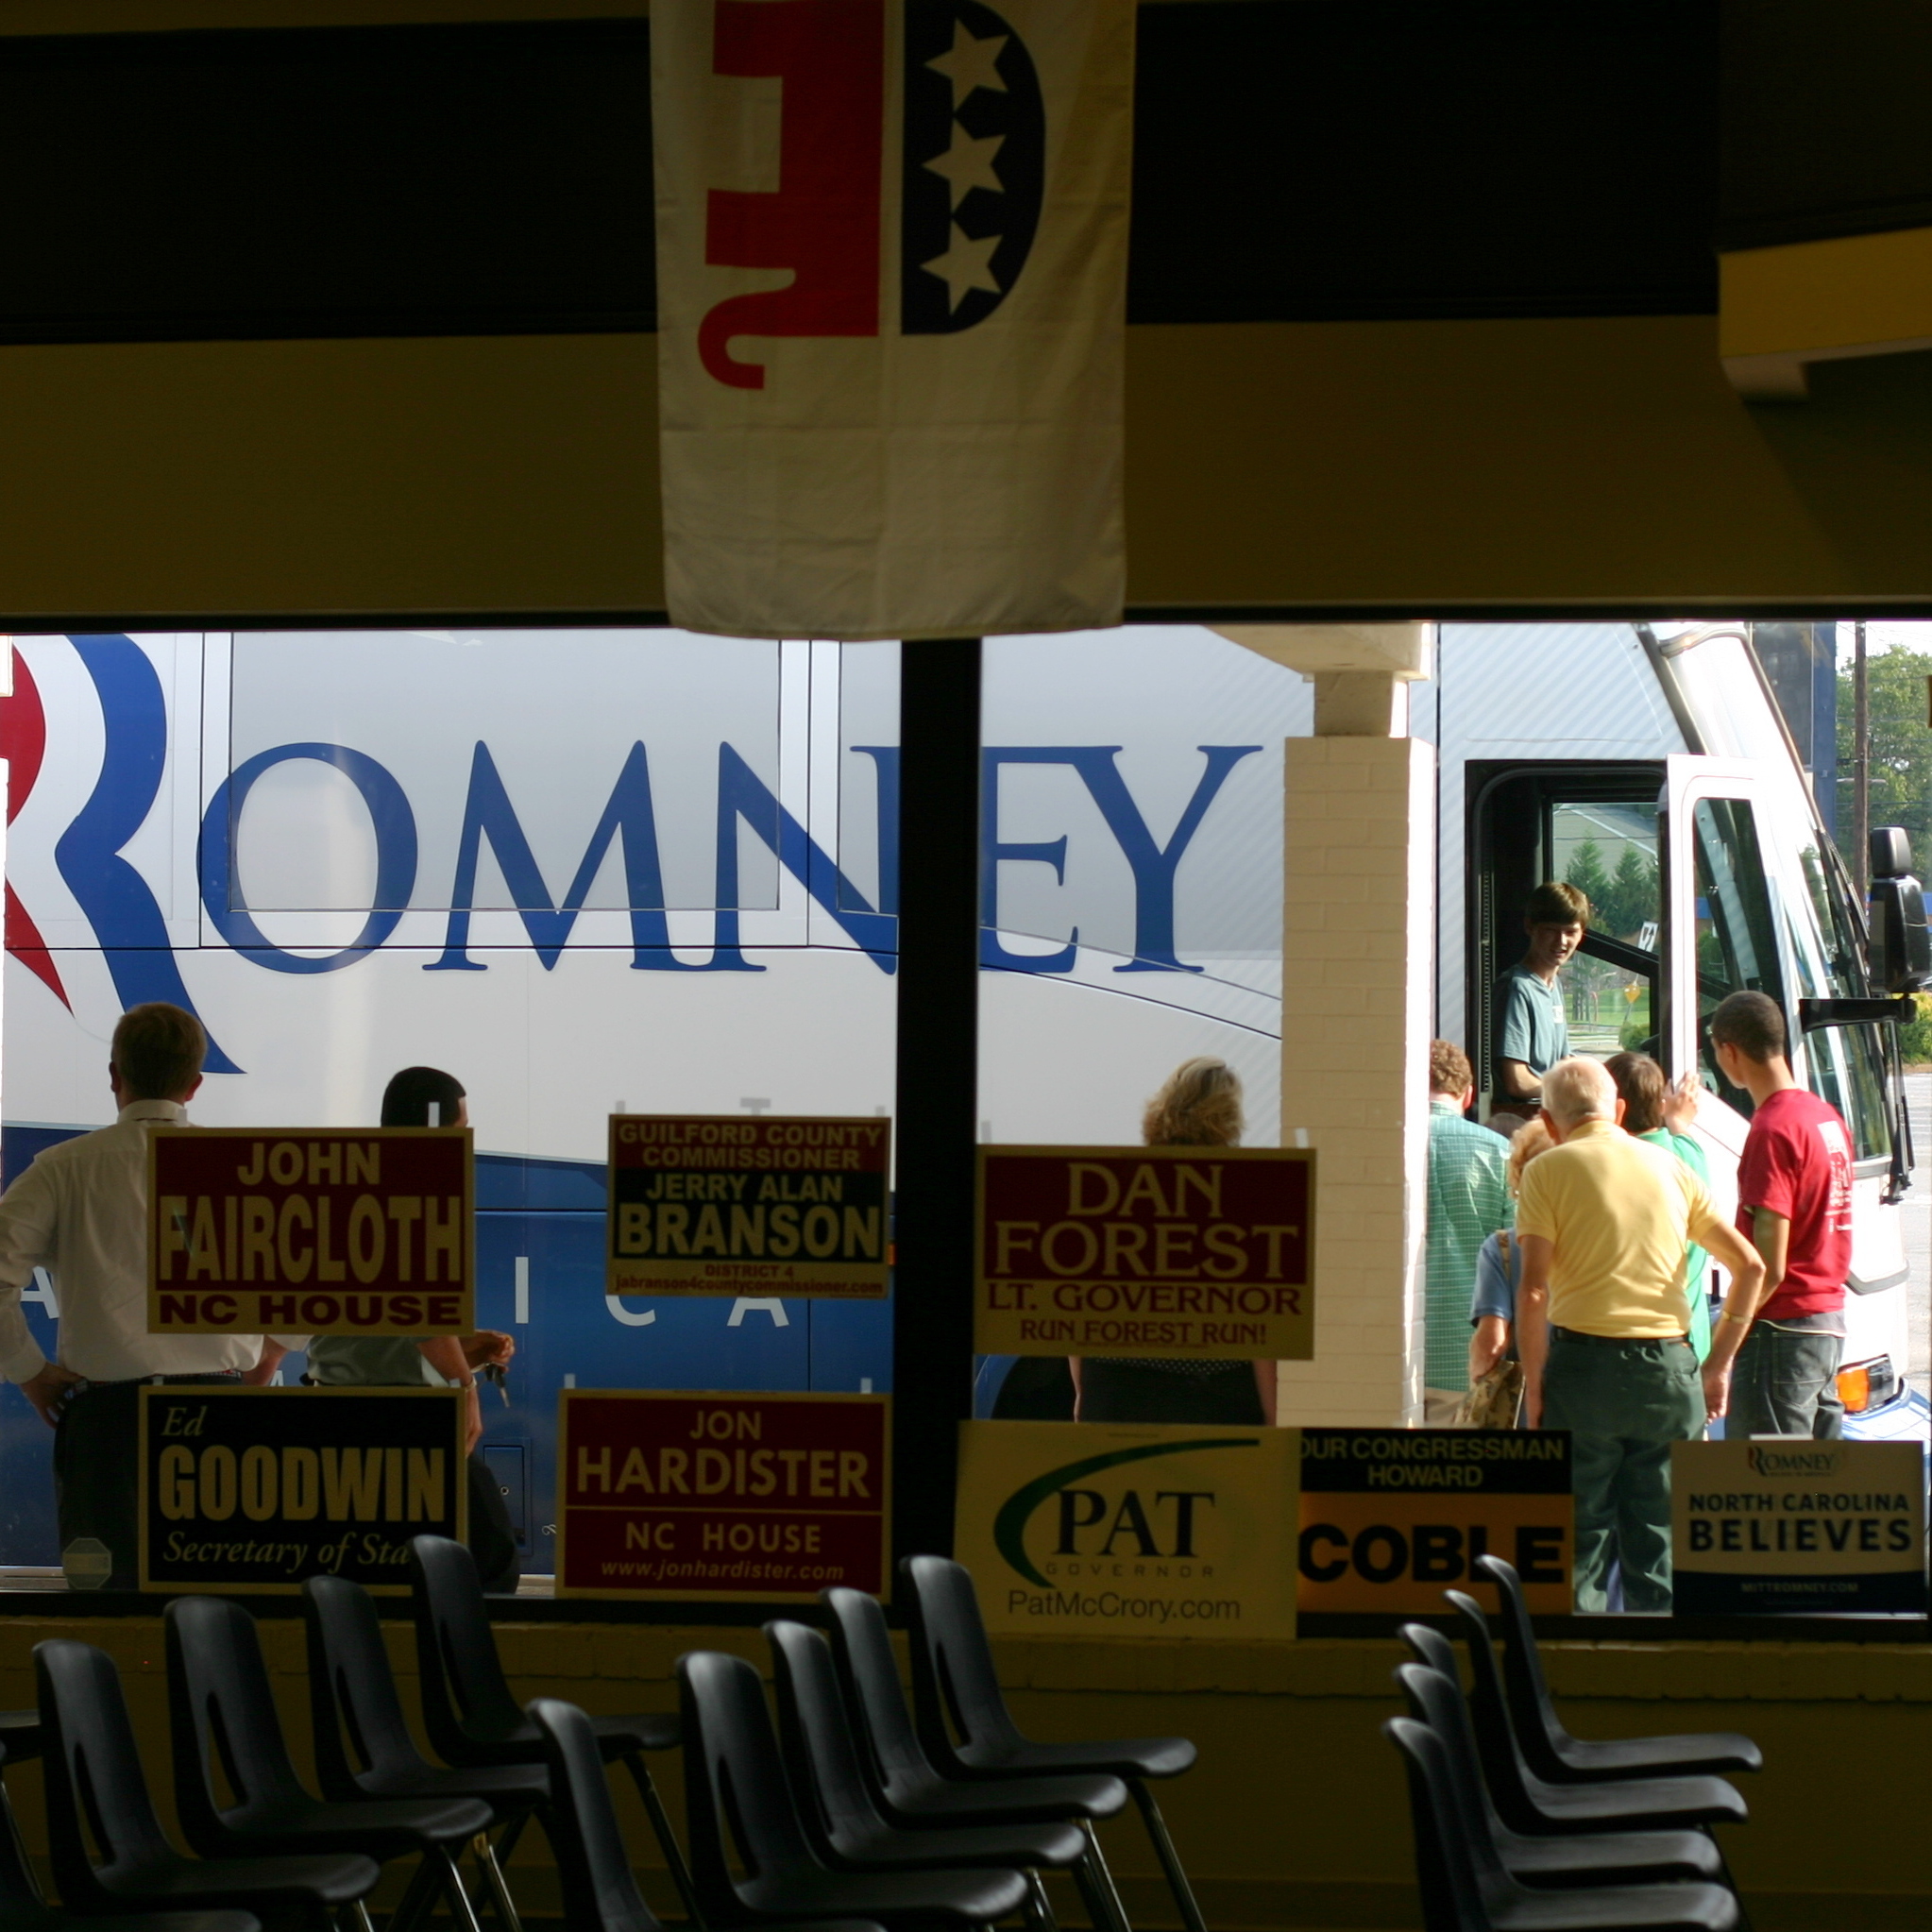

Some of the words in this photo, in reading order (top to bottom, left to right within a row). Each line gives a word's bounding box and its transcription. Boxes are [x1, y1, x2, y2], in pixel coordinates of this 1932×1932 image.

[4, 633, 1263, 1074] ROMNEY
[619, 1123, 756, 1144] GUILFORD
[766, 1125, 883, 1146] COUNTY
[237, 1142, 381, 1185] JOHN
[642, 1145, 860, 1169] COMMISSIONER
[646, 1173, 748, 1200] JERRY
[758, 1175, 843, 1201] ALAN
[1066, 1162, 1224, 1218] DAN
[159, 1194, 461, 1283] FAIRCLOTH
[619, 1202, 880, 1258] BRANSON
[993, 1220, 1298, 1279] FOREST
[615, 1276, 884, 1294] jabranson4countycommissioner.com
[704, 1263, 779, 1278] DISTRICT
[784, 1265, 794, 1278] 4
[159, 1295, 238, 1325] NC
[259, 1296, 461, 1326] HOUSE
[987, 1282, 1037, 1311] LT.
[1052, 1282, 1303, 1315] GOVERNOR
[1020, 1319, 1075, 1342] RUN
[1086, 1320, 1194, 1344] FOREST
[1203, 1322, 1266, 1345] RUN!
[161, 1406, 208, 1436] Ed
[689, 1411, 761, 1440] JON
[1352, 1438, 1564, 1460] CONGRESSMAN
[1747, 1445, 1834, 1476] ROMNEY
[159, 1445, 445, 1521] GOODWIN
[577, 1446, 872, 1498] HARDISTER
[1369, 1466, 1484, 1487] HOWARD
[1689, 1494, 1773, 1512] NORTH
[1782, 1494, 1909, 1512] CAROLINA
[625, 1521, 676, 1551] NC
[703, 1523, 822, 1553] HOUSE
[1052, 1488, 1215, 1558] PAT
[1689, 1518, 1912, 1552] BELIEVES
[163, 1531, 308, 1574] Secretary
[317, 1532, 357, 1574] of
[358, 1533, 410, 1566] Sta
[1298, 1523, 1565, 1584] COBLE
[601, 1558, 845, 1581] www.jonhardister.com
[1045, 1562, 1214, 1578] GOVERNOR
[1008, 1590, 1241, 1624] PatMcCrory.com
